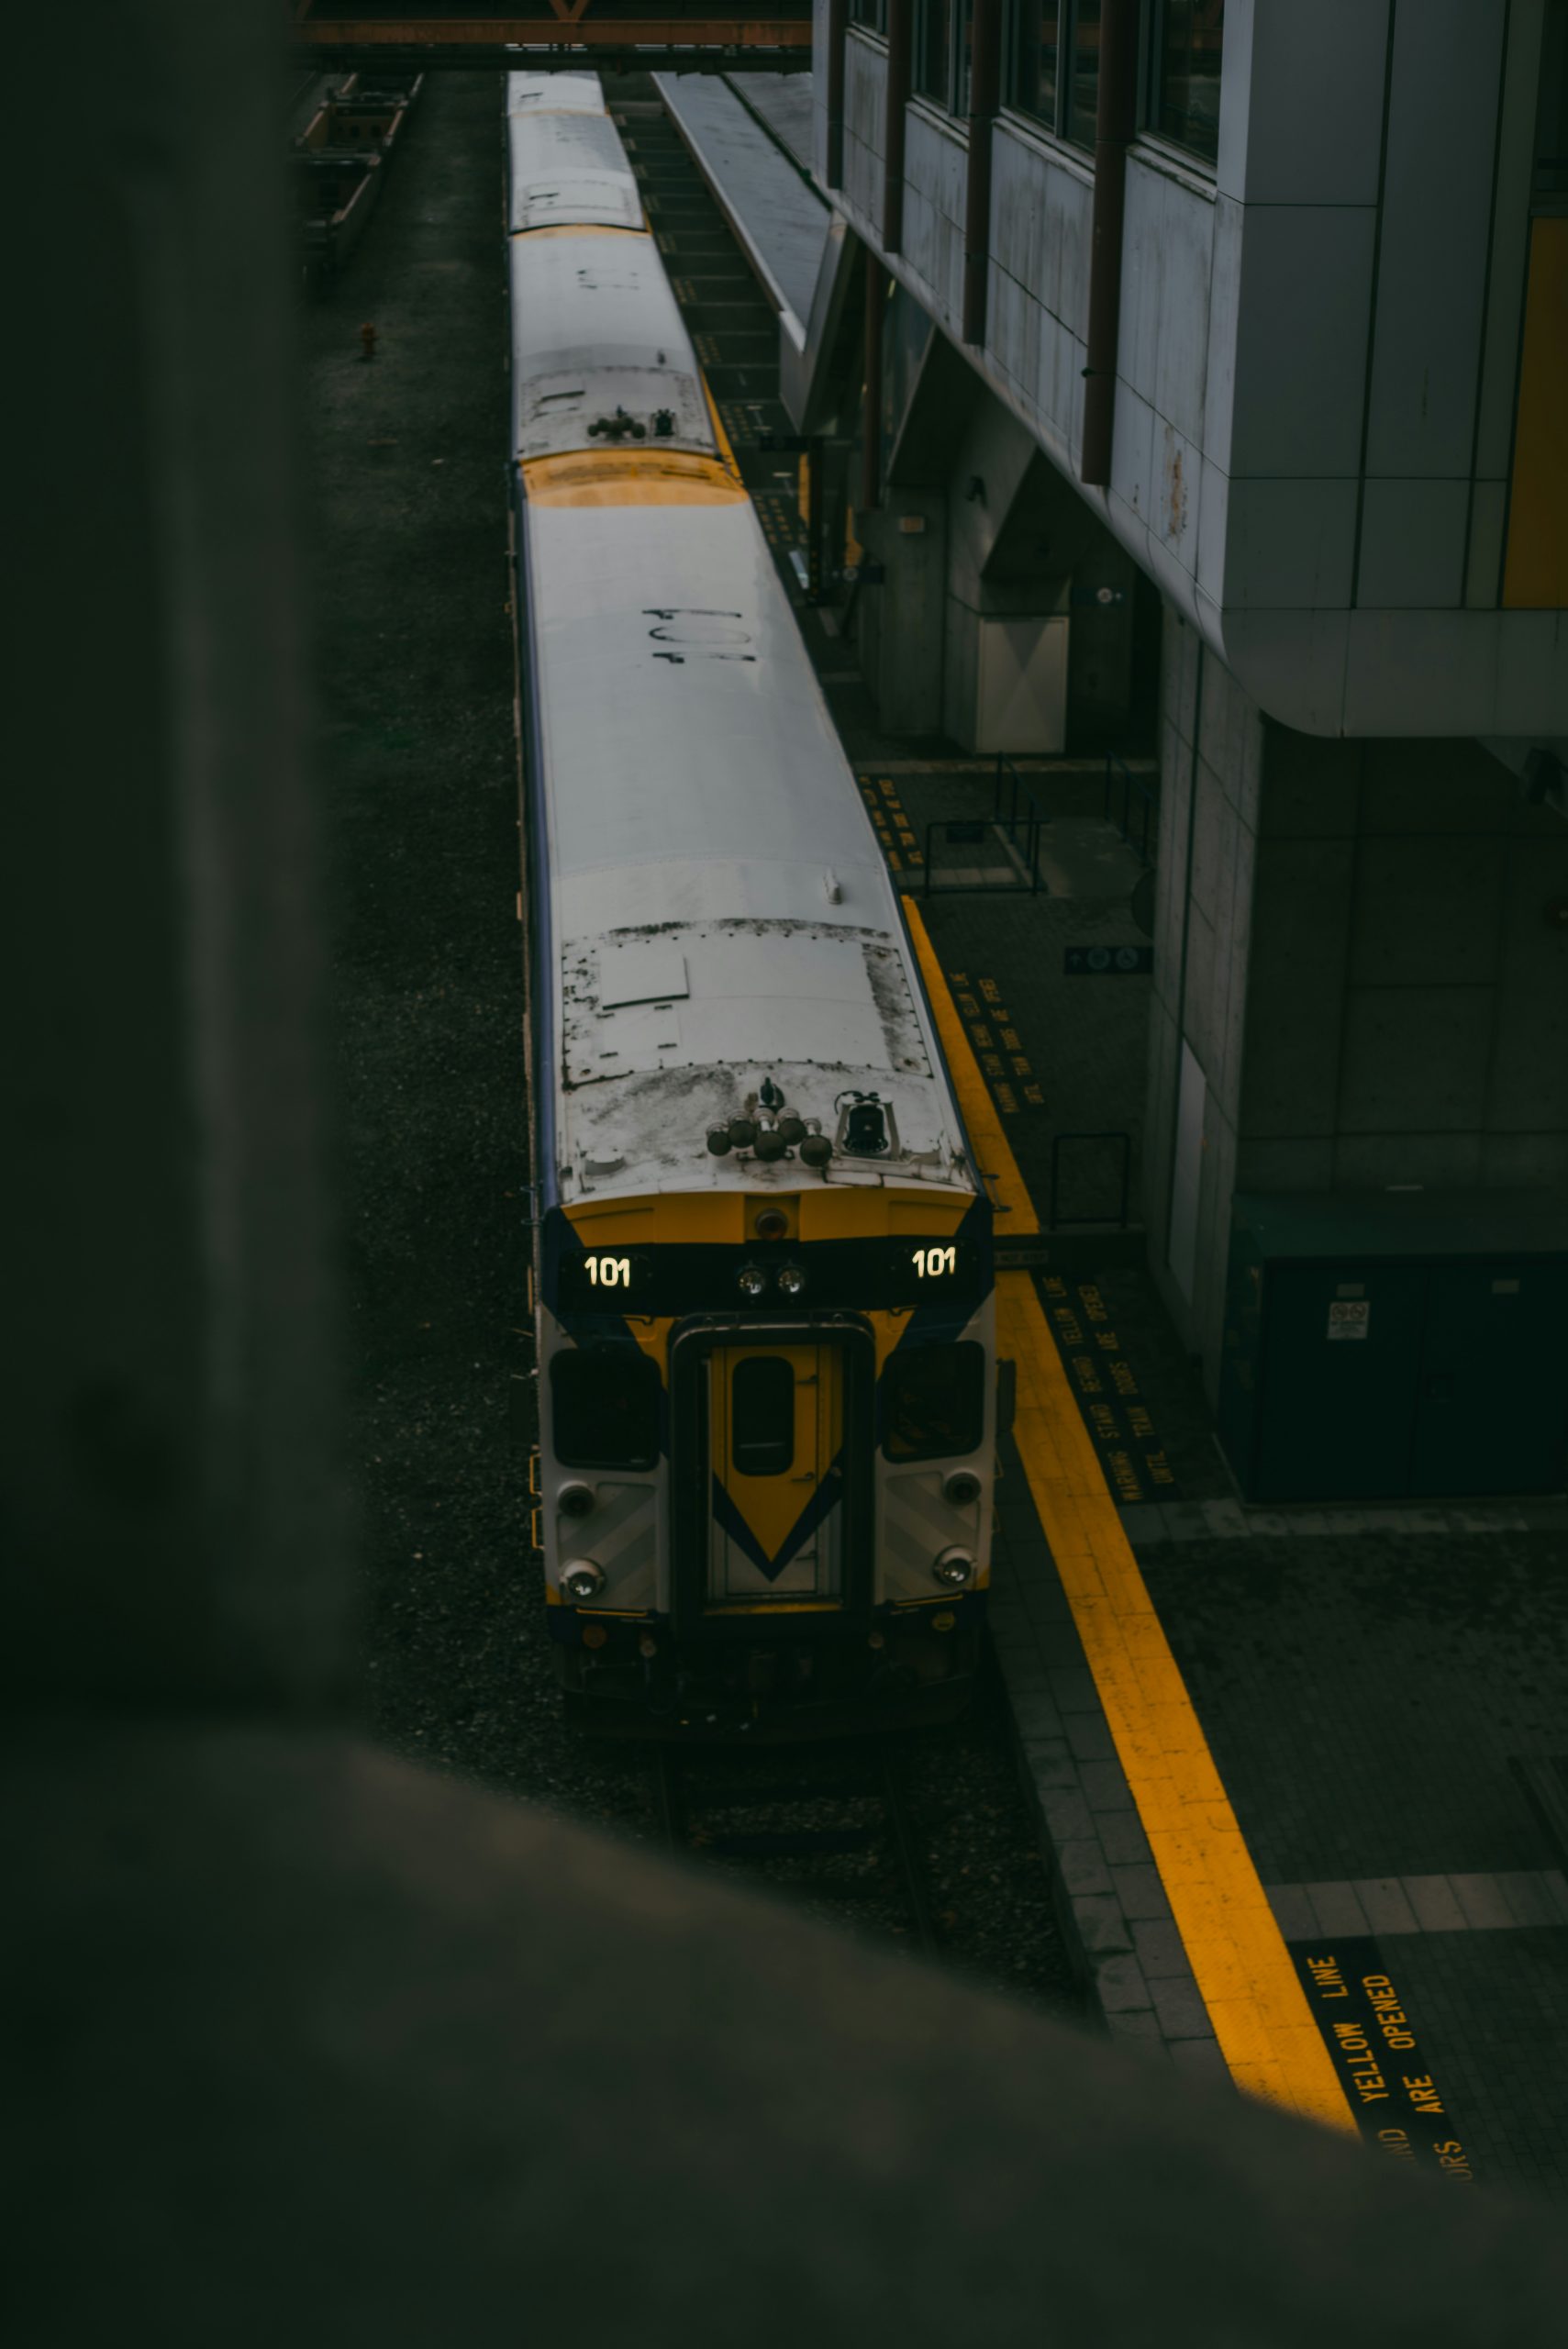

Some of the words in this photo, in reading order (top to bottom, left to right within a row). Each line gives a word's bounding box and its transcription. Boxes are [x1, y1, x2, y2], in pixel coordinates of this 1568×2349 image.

[584, 1256, 631, 1287] 101
[912, 1246, 957, 1277] 101
[1307, 1955, 1349, 1998] LINE
[1362, 1975, 1416, 2049] OPENED
[1333, 2023, 1389, 2103] YELLOW
[1403, 2075, 1444, 2113] ARE
